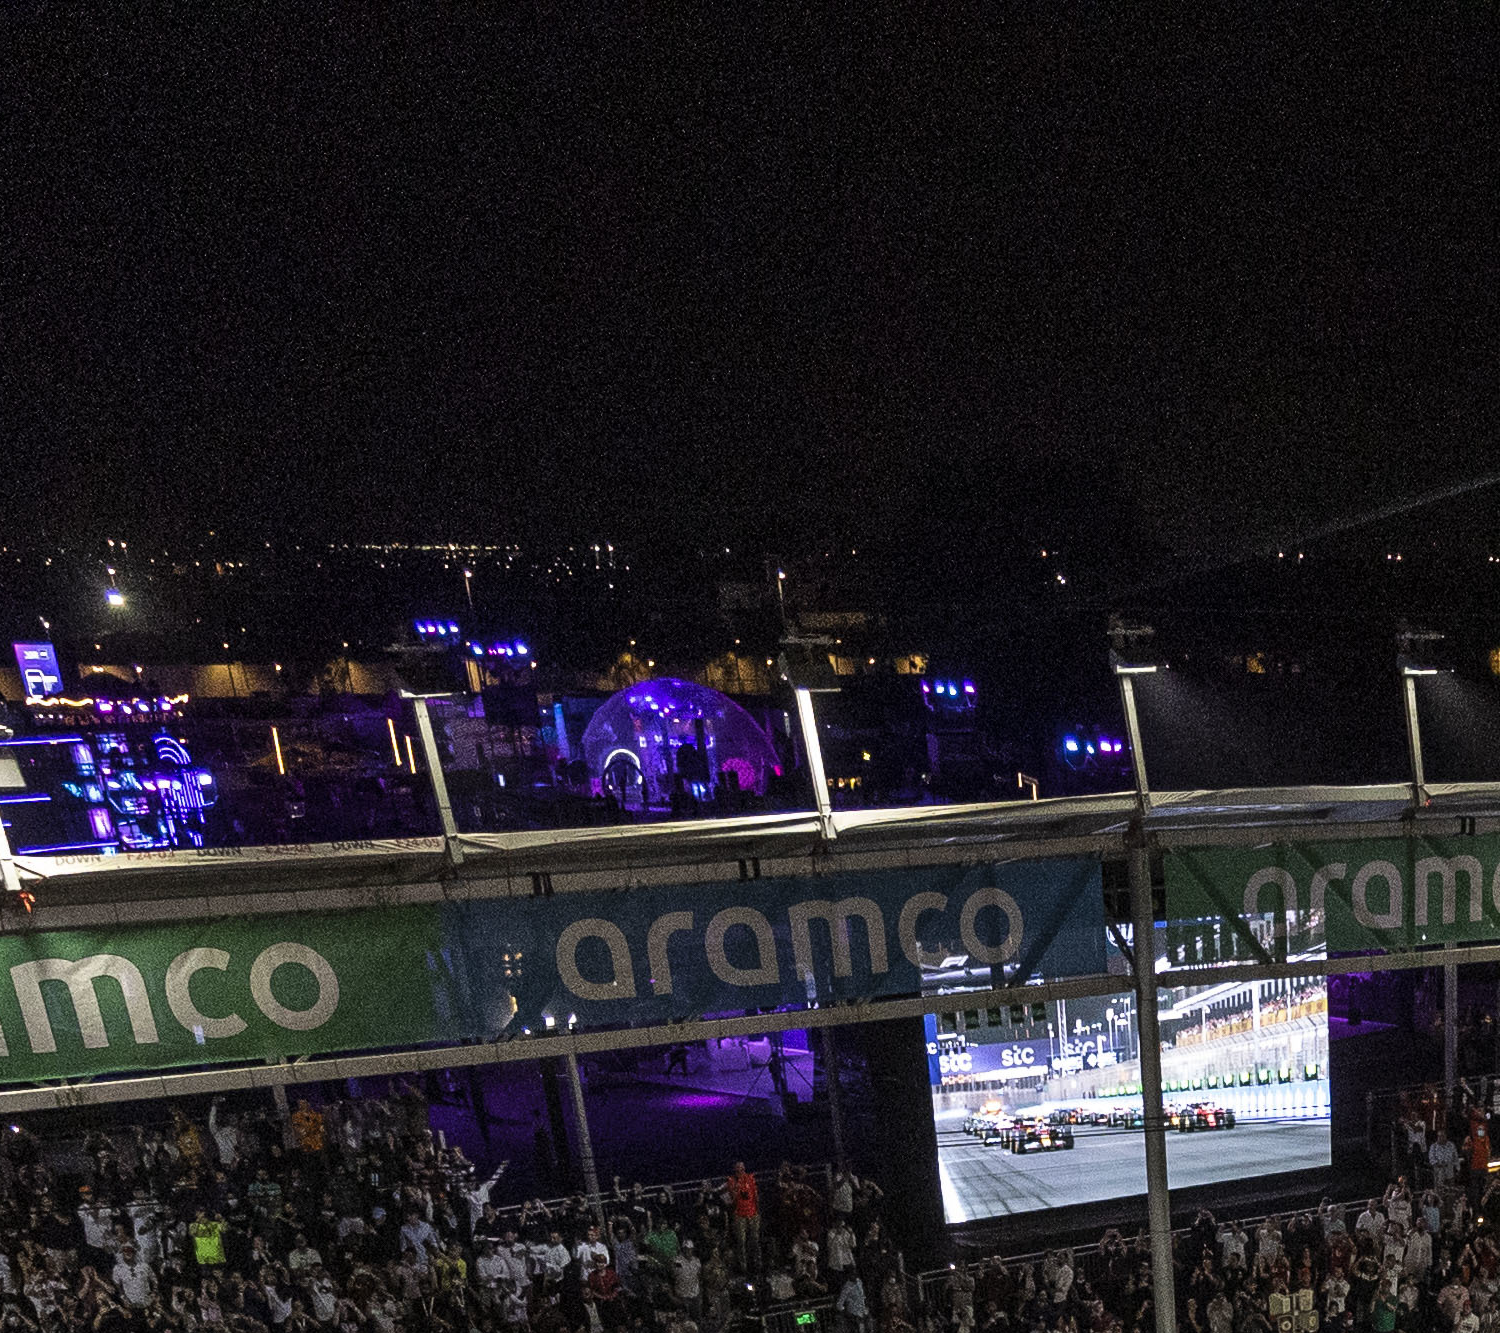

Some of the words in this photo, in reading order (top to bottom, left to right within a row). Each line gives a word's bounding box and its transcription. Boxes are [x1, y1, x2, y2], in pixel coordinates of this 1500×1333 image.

[555, 885, 1024, 1001] aramco
[939, 1052, 972, 1074] stc
[1001, 1044, 1035, 1067] stc
